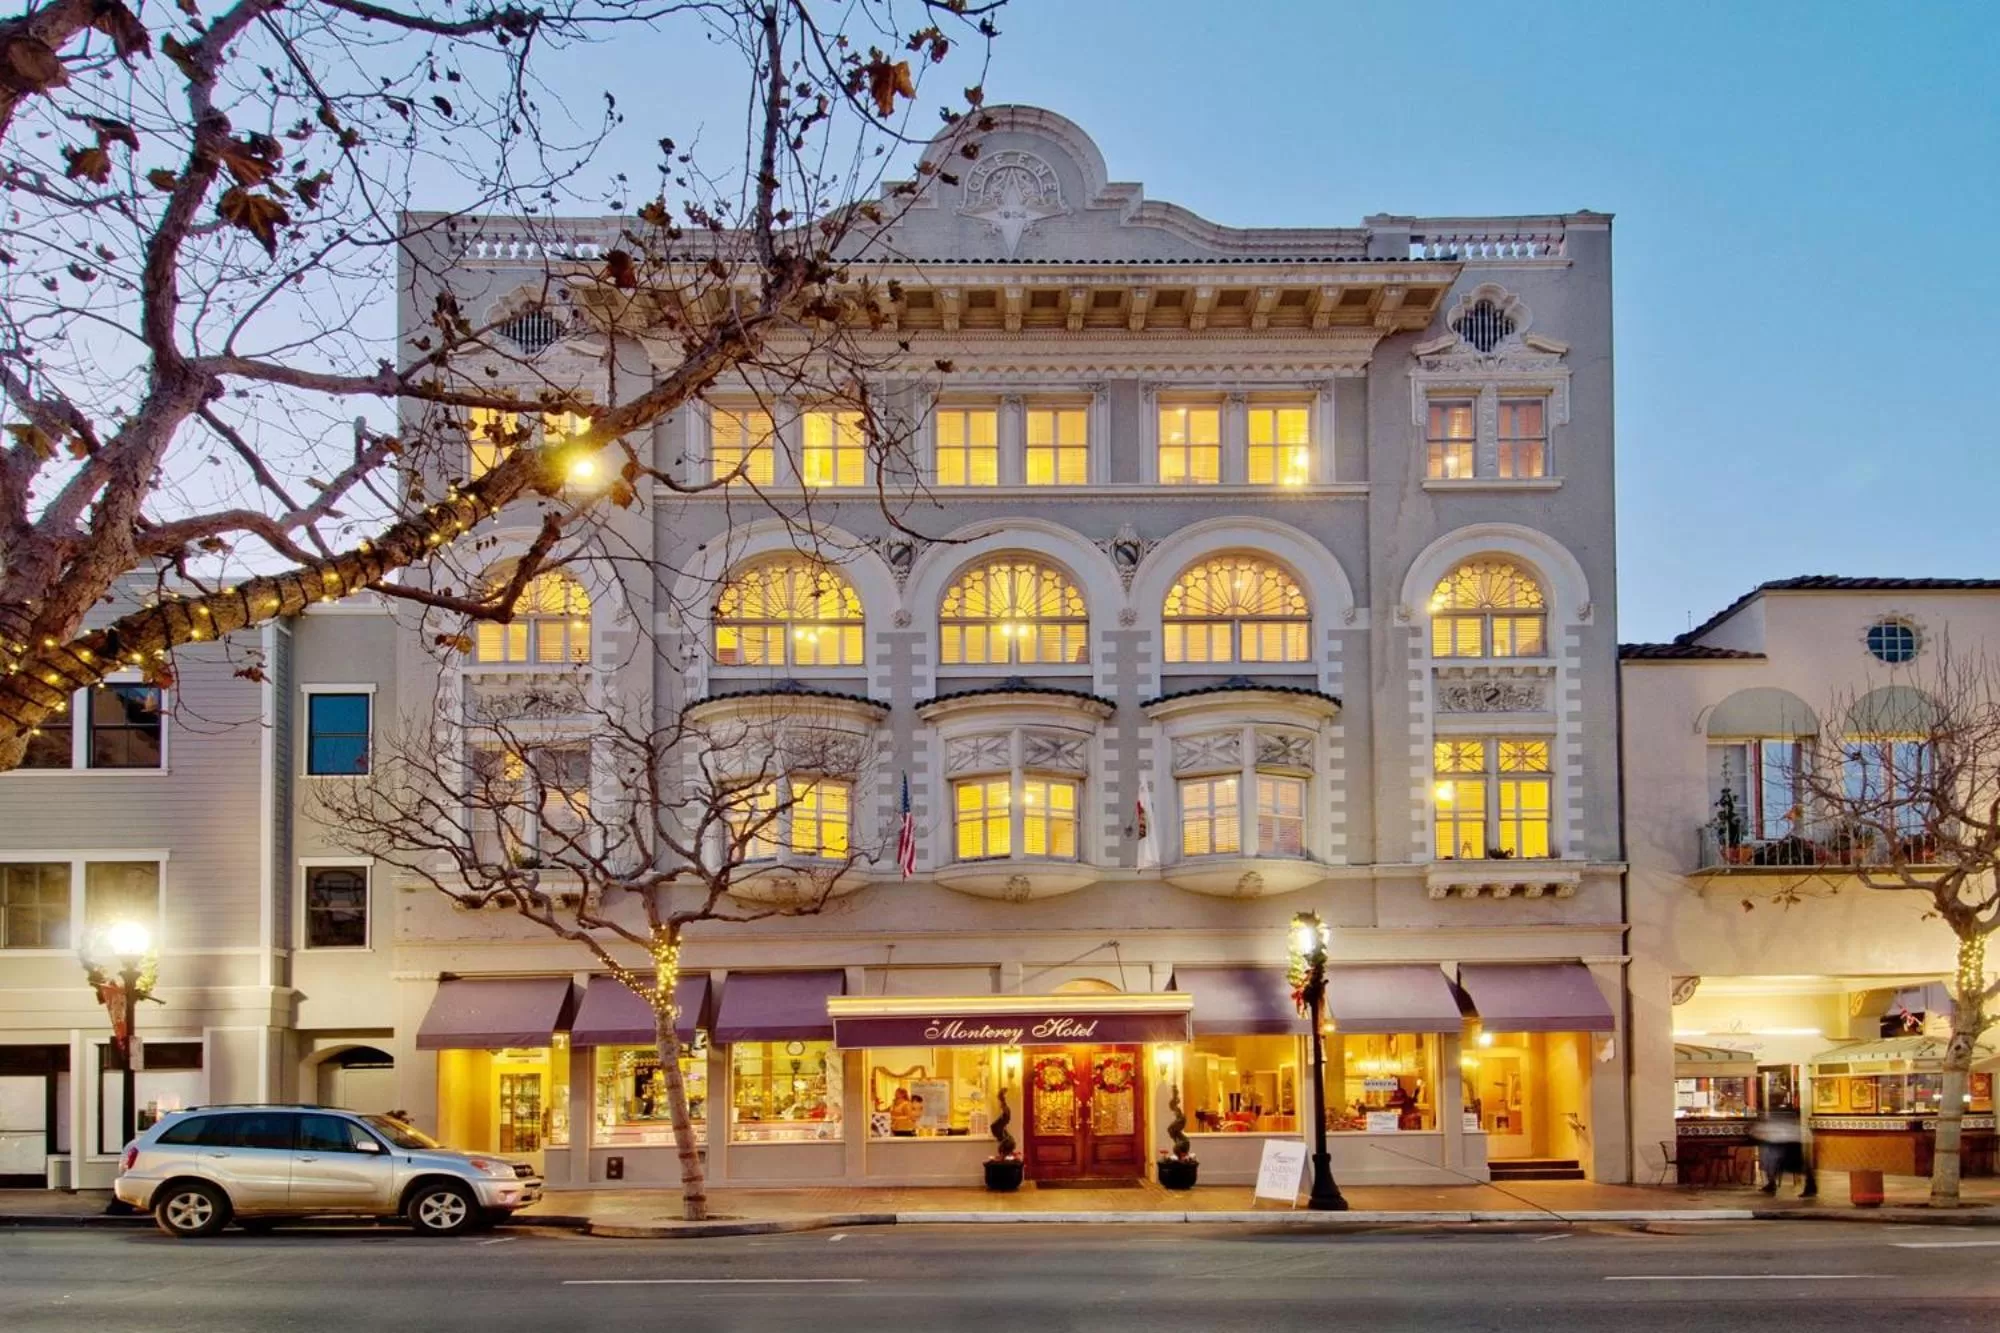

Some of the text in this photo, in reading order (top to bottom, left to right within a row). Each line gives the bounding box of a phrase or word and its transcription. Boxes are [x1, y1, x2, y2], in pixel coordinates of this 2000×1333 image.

[968, 154, 1059, 193] GREENE
[924, 1019, 1023, 1045] Monterey
[1031, 1017, 1098, 1038] Hotel
